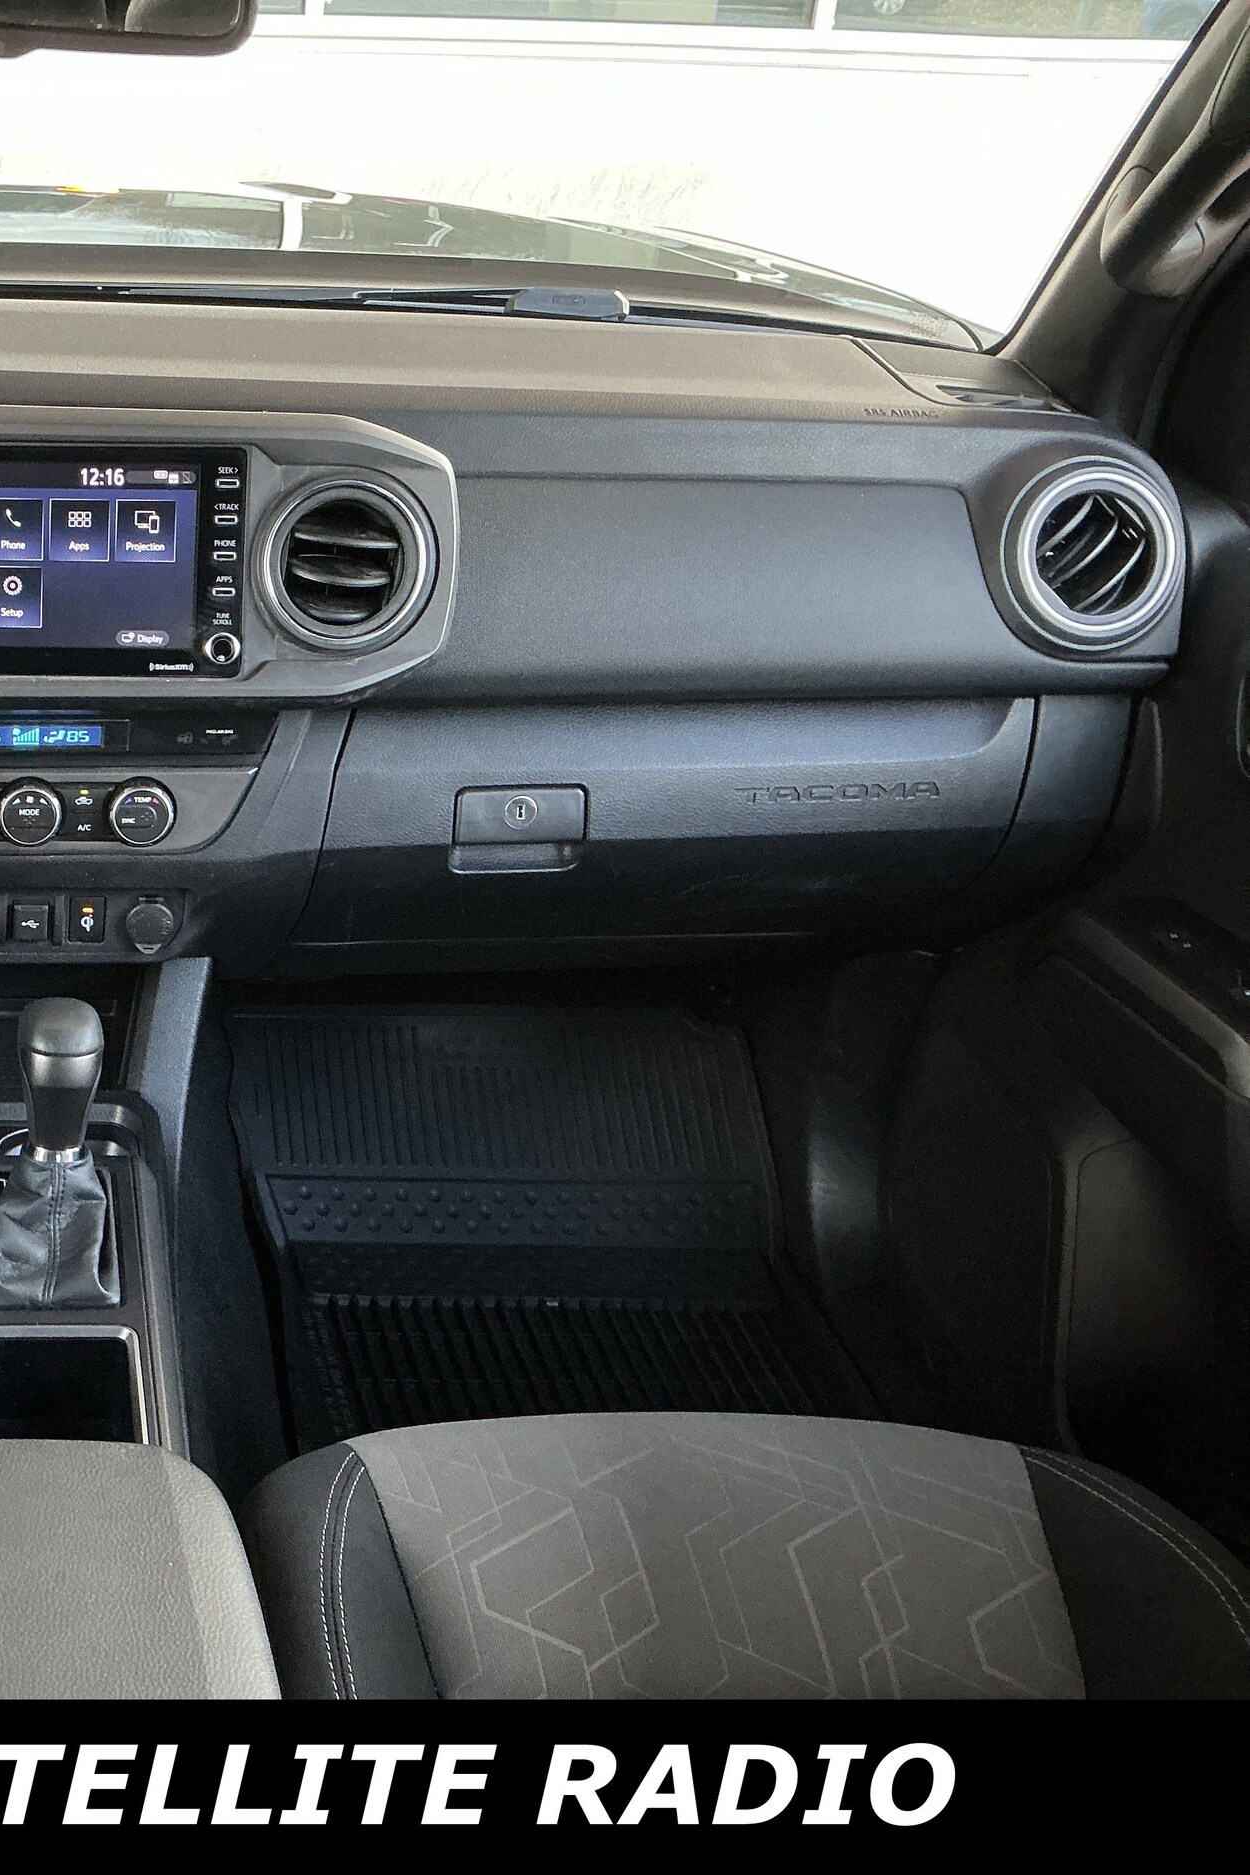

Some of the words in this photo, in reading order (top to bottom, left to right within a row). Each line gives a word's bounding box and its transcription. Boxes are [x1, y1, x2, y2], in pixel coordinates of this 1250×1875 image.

[890, 409, 938, 419] AIRBAG
[80, 468, 125, 486] 12:16
[0, 540, 26, 550] Phone
[69, 541, 90, 552] Apps
[125, 541, 165, 552] Projection
[0, 607, 24, 618] Setup
[137, 634, 163, 644] Display
[66, 730, 90, 743] 85
[734, 781, 940, 805] TACOMA
[77, 824, 92, 832] A/C
